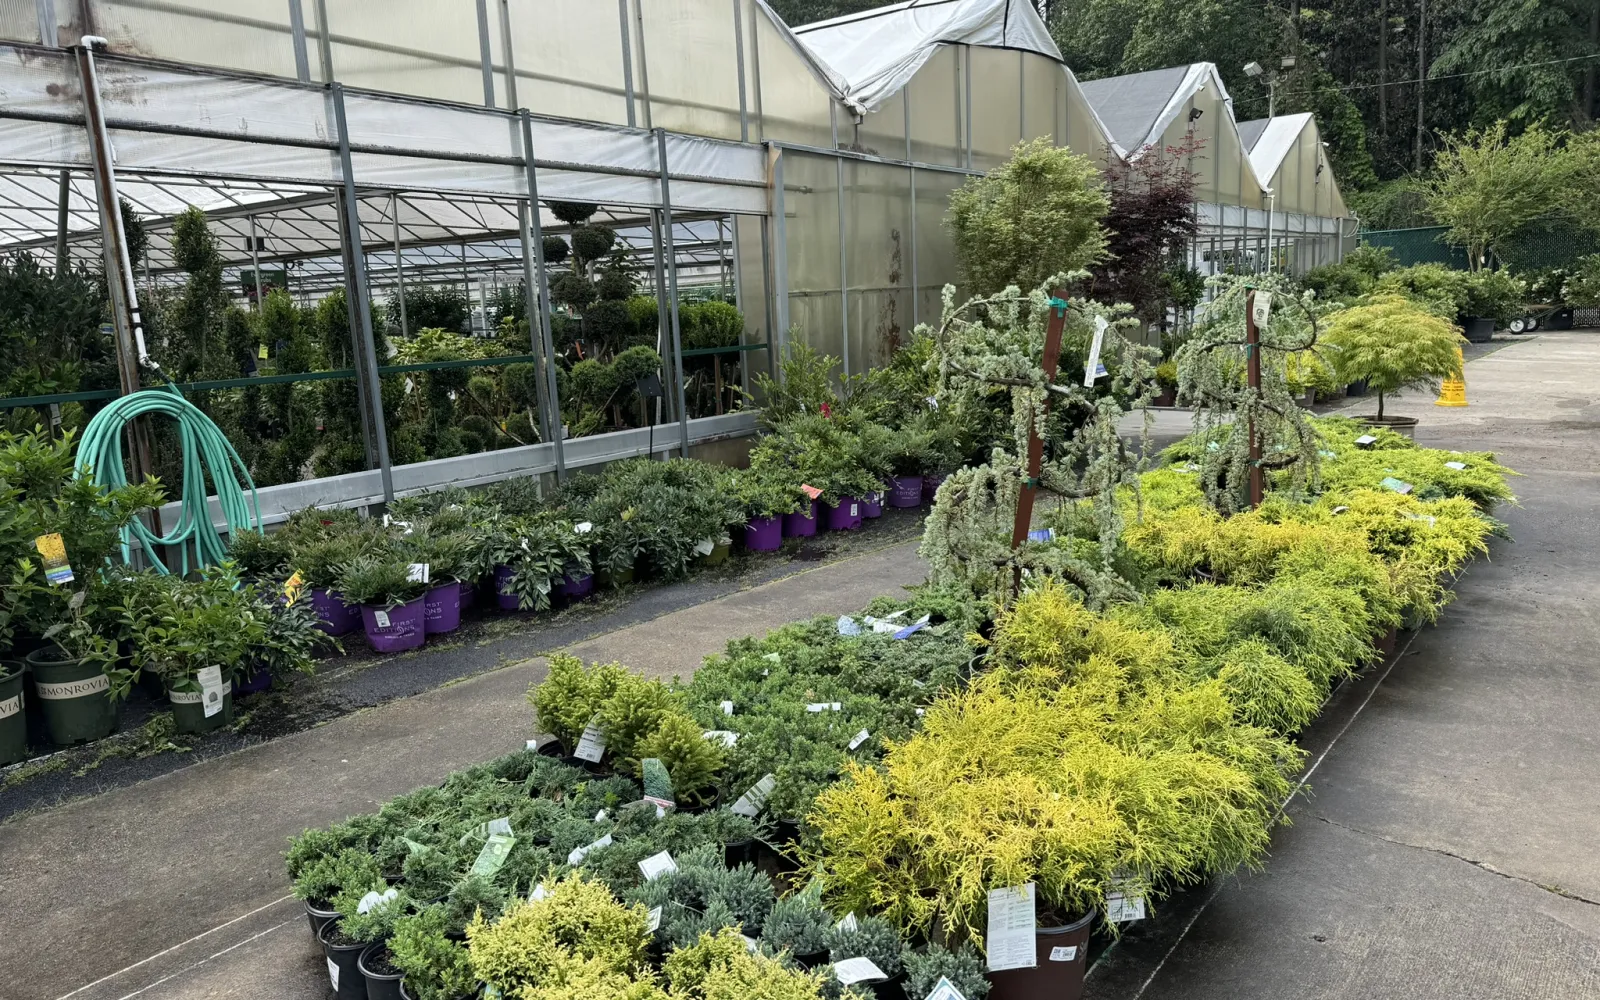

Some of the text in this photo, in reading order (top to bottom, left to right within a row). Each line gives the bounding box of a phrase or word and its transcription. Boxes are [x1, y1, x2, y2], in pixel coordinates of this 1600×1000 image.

[250, 271, 275, 279] Evgreen
[392, 618, 415, 627] FIRST
[373, 624, 415, 634] EDITIONS
[47, 678, 109, 696] MONROVIA
